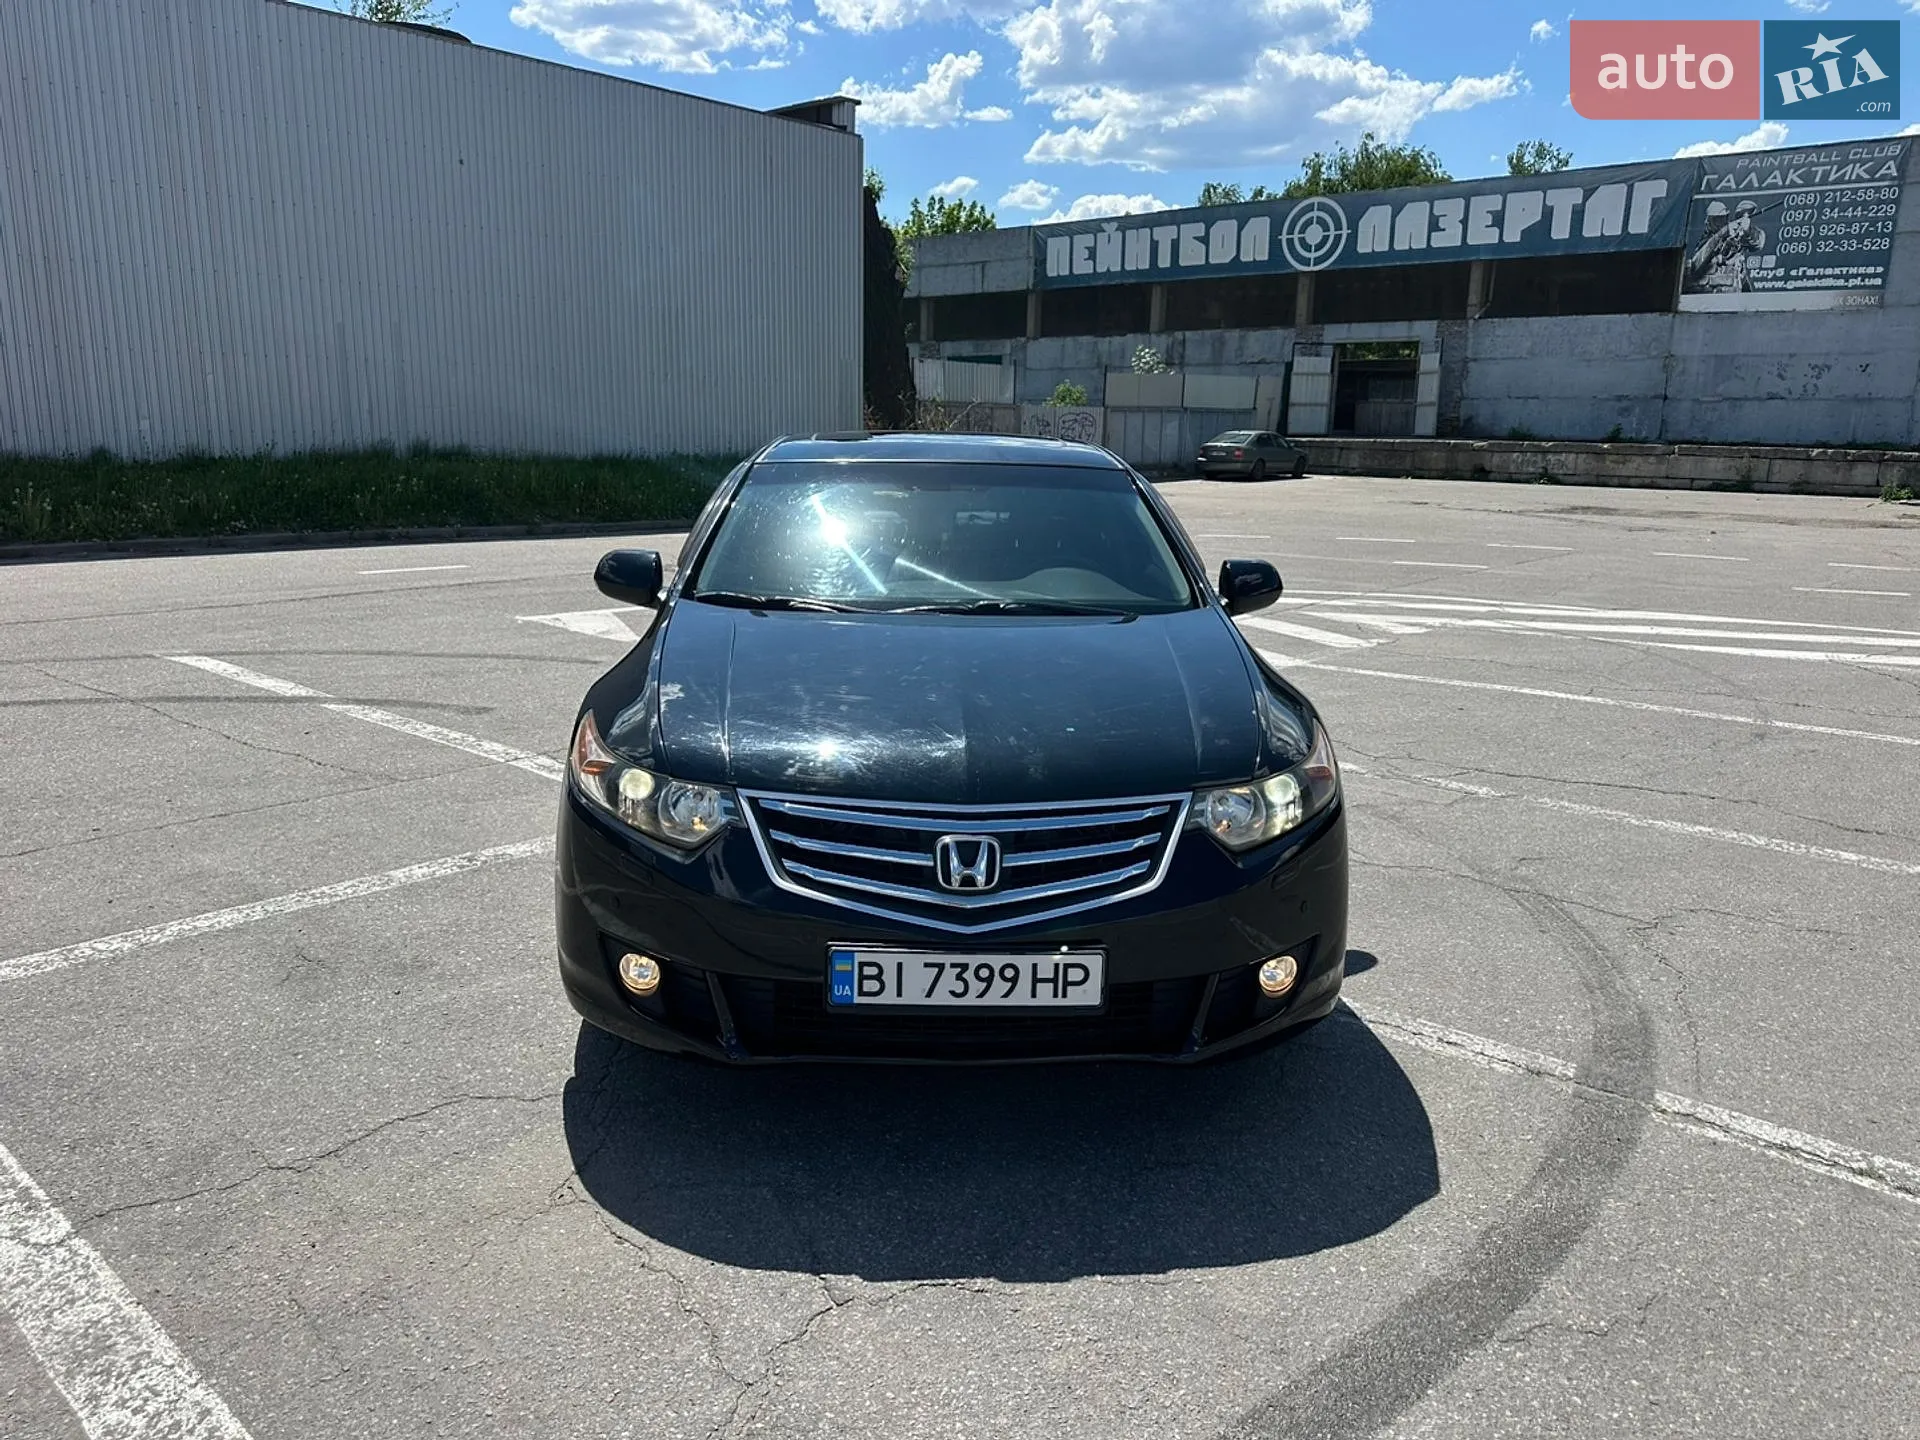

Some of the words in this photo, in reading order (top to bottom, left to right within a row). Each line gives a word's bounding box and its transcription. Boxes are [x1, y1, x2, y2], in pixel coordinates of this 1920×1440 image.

[1736, 151, 1841, 169] PAINTBALL
[1848, 143, 1901, 159] CLUB
[1701, 160, 1899, 191] ГАЛАКТИКА
[1784, 193, 1820, 208] (068)
[1824, 187, 1899, 203] 212-58-80
[1781, 209, 1817, 224] (097)
[1821, 204, 1896, 220] 34-44-229
[1046, 216, 1270, 277] ПЕЙНТБОЛ
[1357, 179, 1668, 254] ЛАЗЕРТАГ
[1778, 225, 1815, 240] (095)
[1819, 221, 1893, 236] 926-87-13
[1776, 241, 1812, 256] (066)
[1816, 237, 1890, 252] 32-33-528
[1750, 268, 1785, 279] Клуб
[923, 962, 1020, 998] 7399
[834, 985, 851, 996] UA
